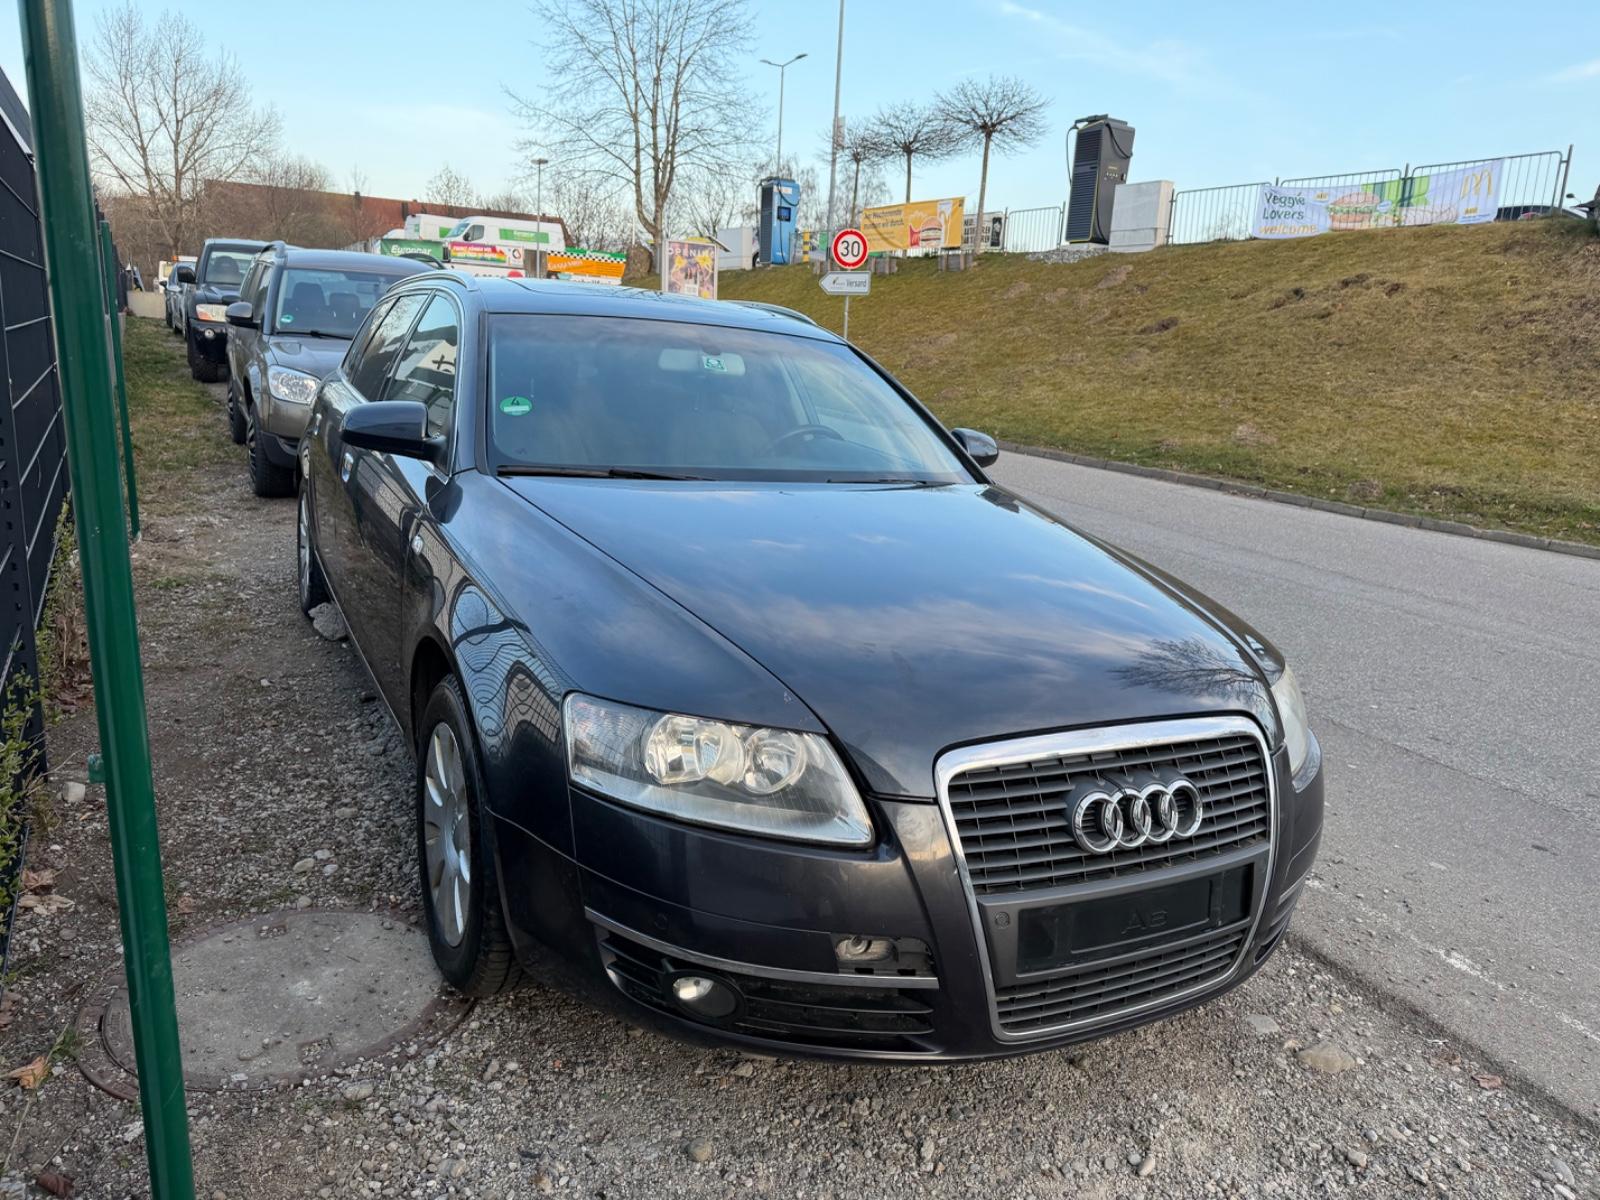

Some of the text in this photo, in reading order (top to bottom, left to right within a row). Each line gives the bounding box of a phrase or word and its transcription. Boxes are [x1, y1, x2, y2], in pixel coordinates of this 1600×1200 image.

[1264, 192, 1305, 208] Veggie
[1262, 208, 1304, 220] Lovers
[1259, 224, 1317, 234] welcome
[841, 240, 860, 257] 30
[846, 279, 866, 288] Versand
